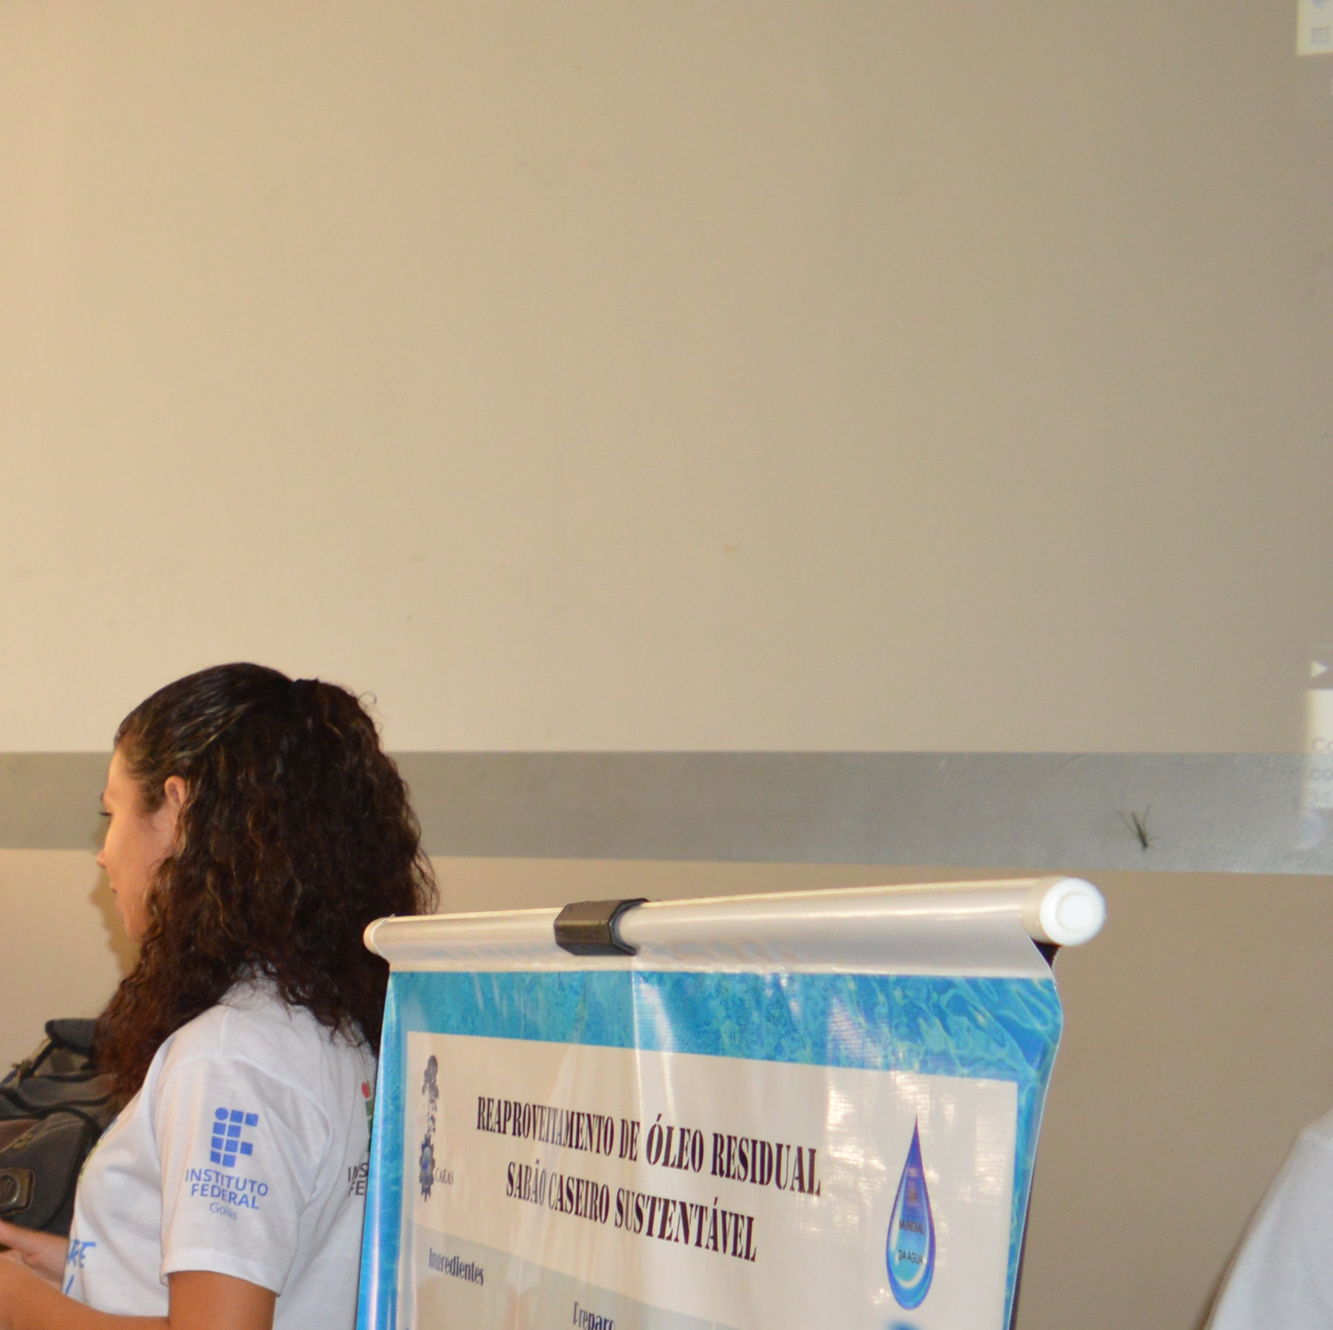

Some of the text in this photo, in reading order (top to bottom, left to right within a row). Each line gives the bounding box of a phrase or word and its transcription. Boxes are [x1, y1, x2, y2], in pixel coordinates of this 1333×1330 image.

[476, 1096, 821, 1197] REAPROVEITAMENTO DE ÓLEO RESIDUAL
[186, 1168, 269, 1197] INSTITUTO
[190, 1183, 260, 1210] FEDERAL
[506, 1158, 756, 1263] SABÃO CASEIRO SUSTENTÁVEL
[428, 1247, 485, 1287] Ingredientes
